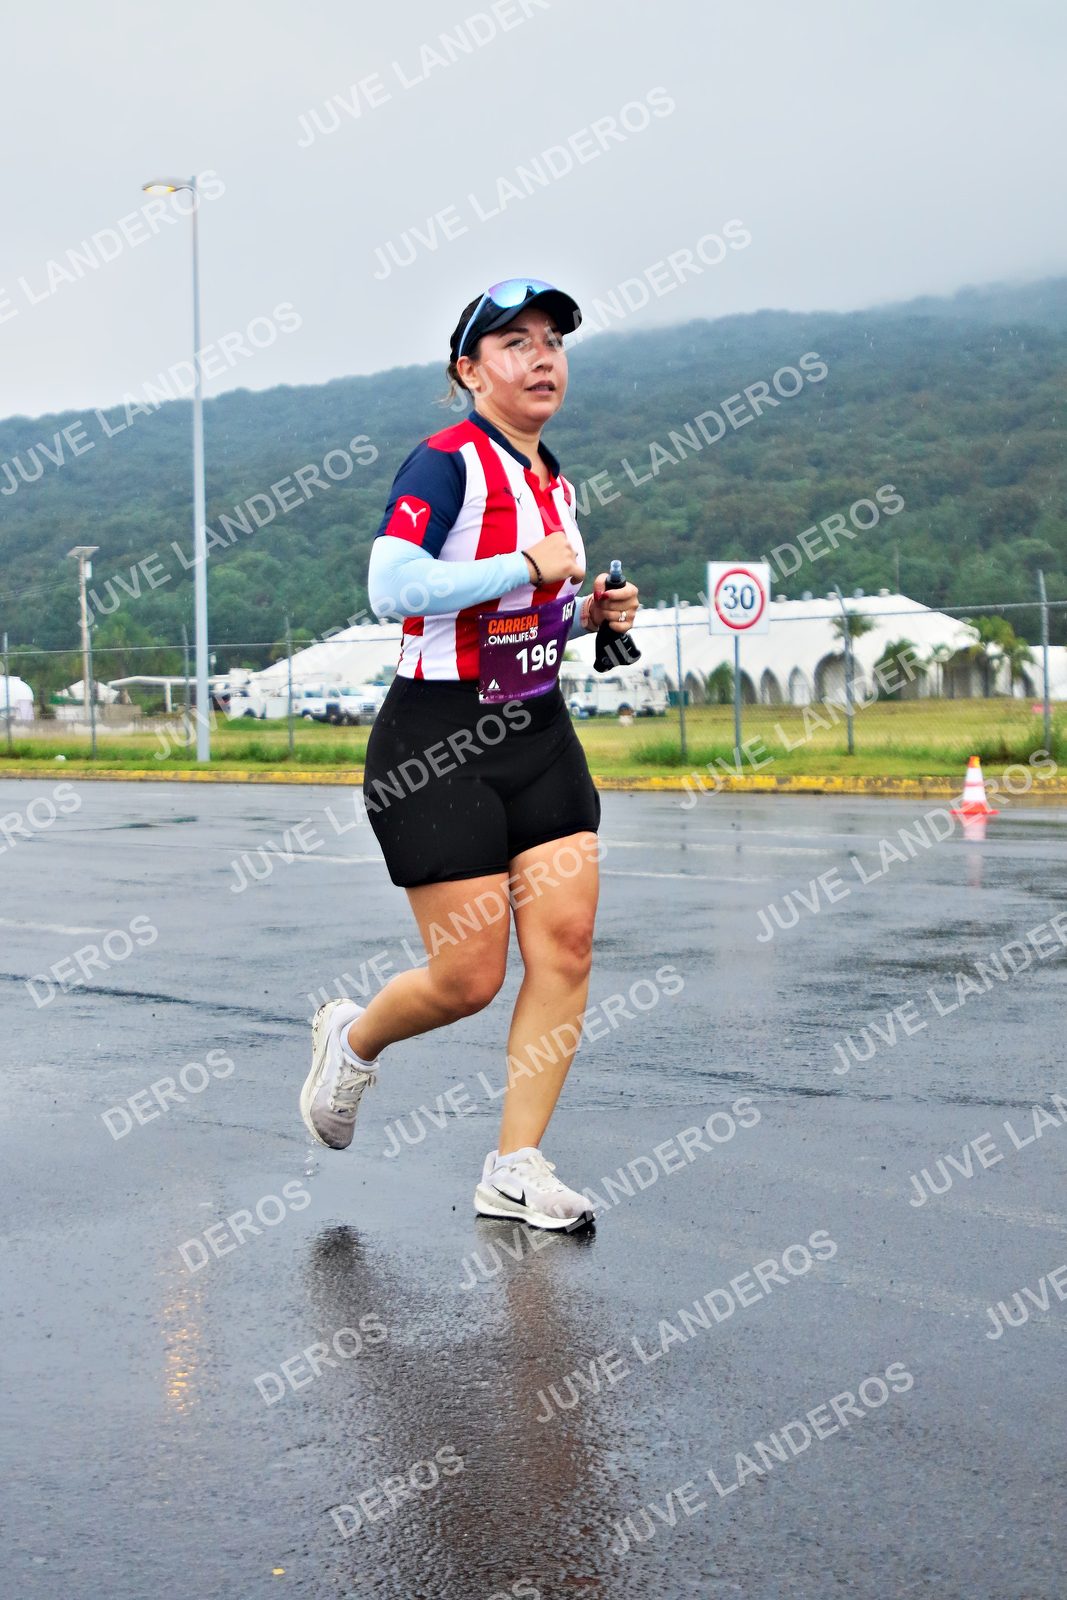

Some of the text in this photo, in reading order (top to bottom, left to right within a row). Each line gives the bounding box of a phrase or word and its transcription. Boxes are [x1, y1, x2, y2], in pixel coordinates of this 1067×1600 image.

[723, 584, 755, 610] 30
[488, 613, 539, 634] CARRERA
[516, 639, 558, 674] 196
